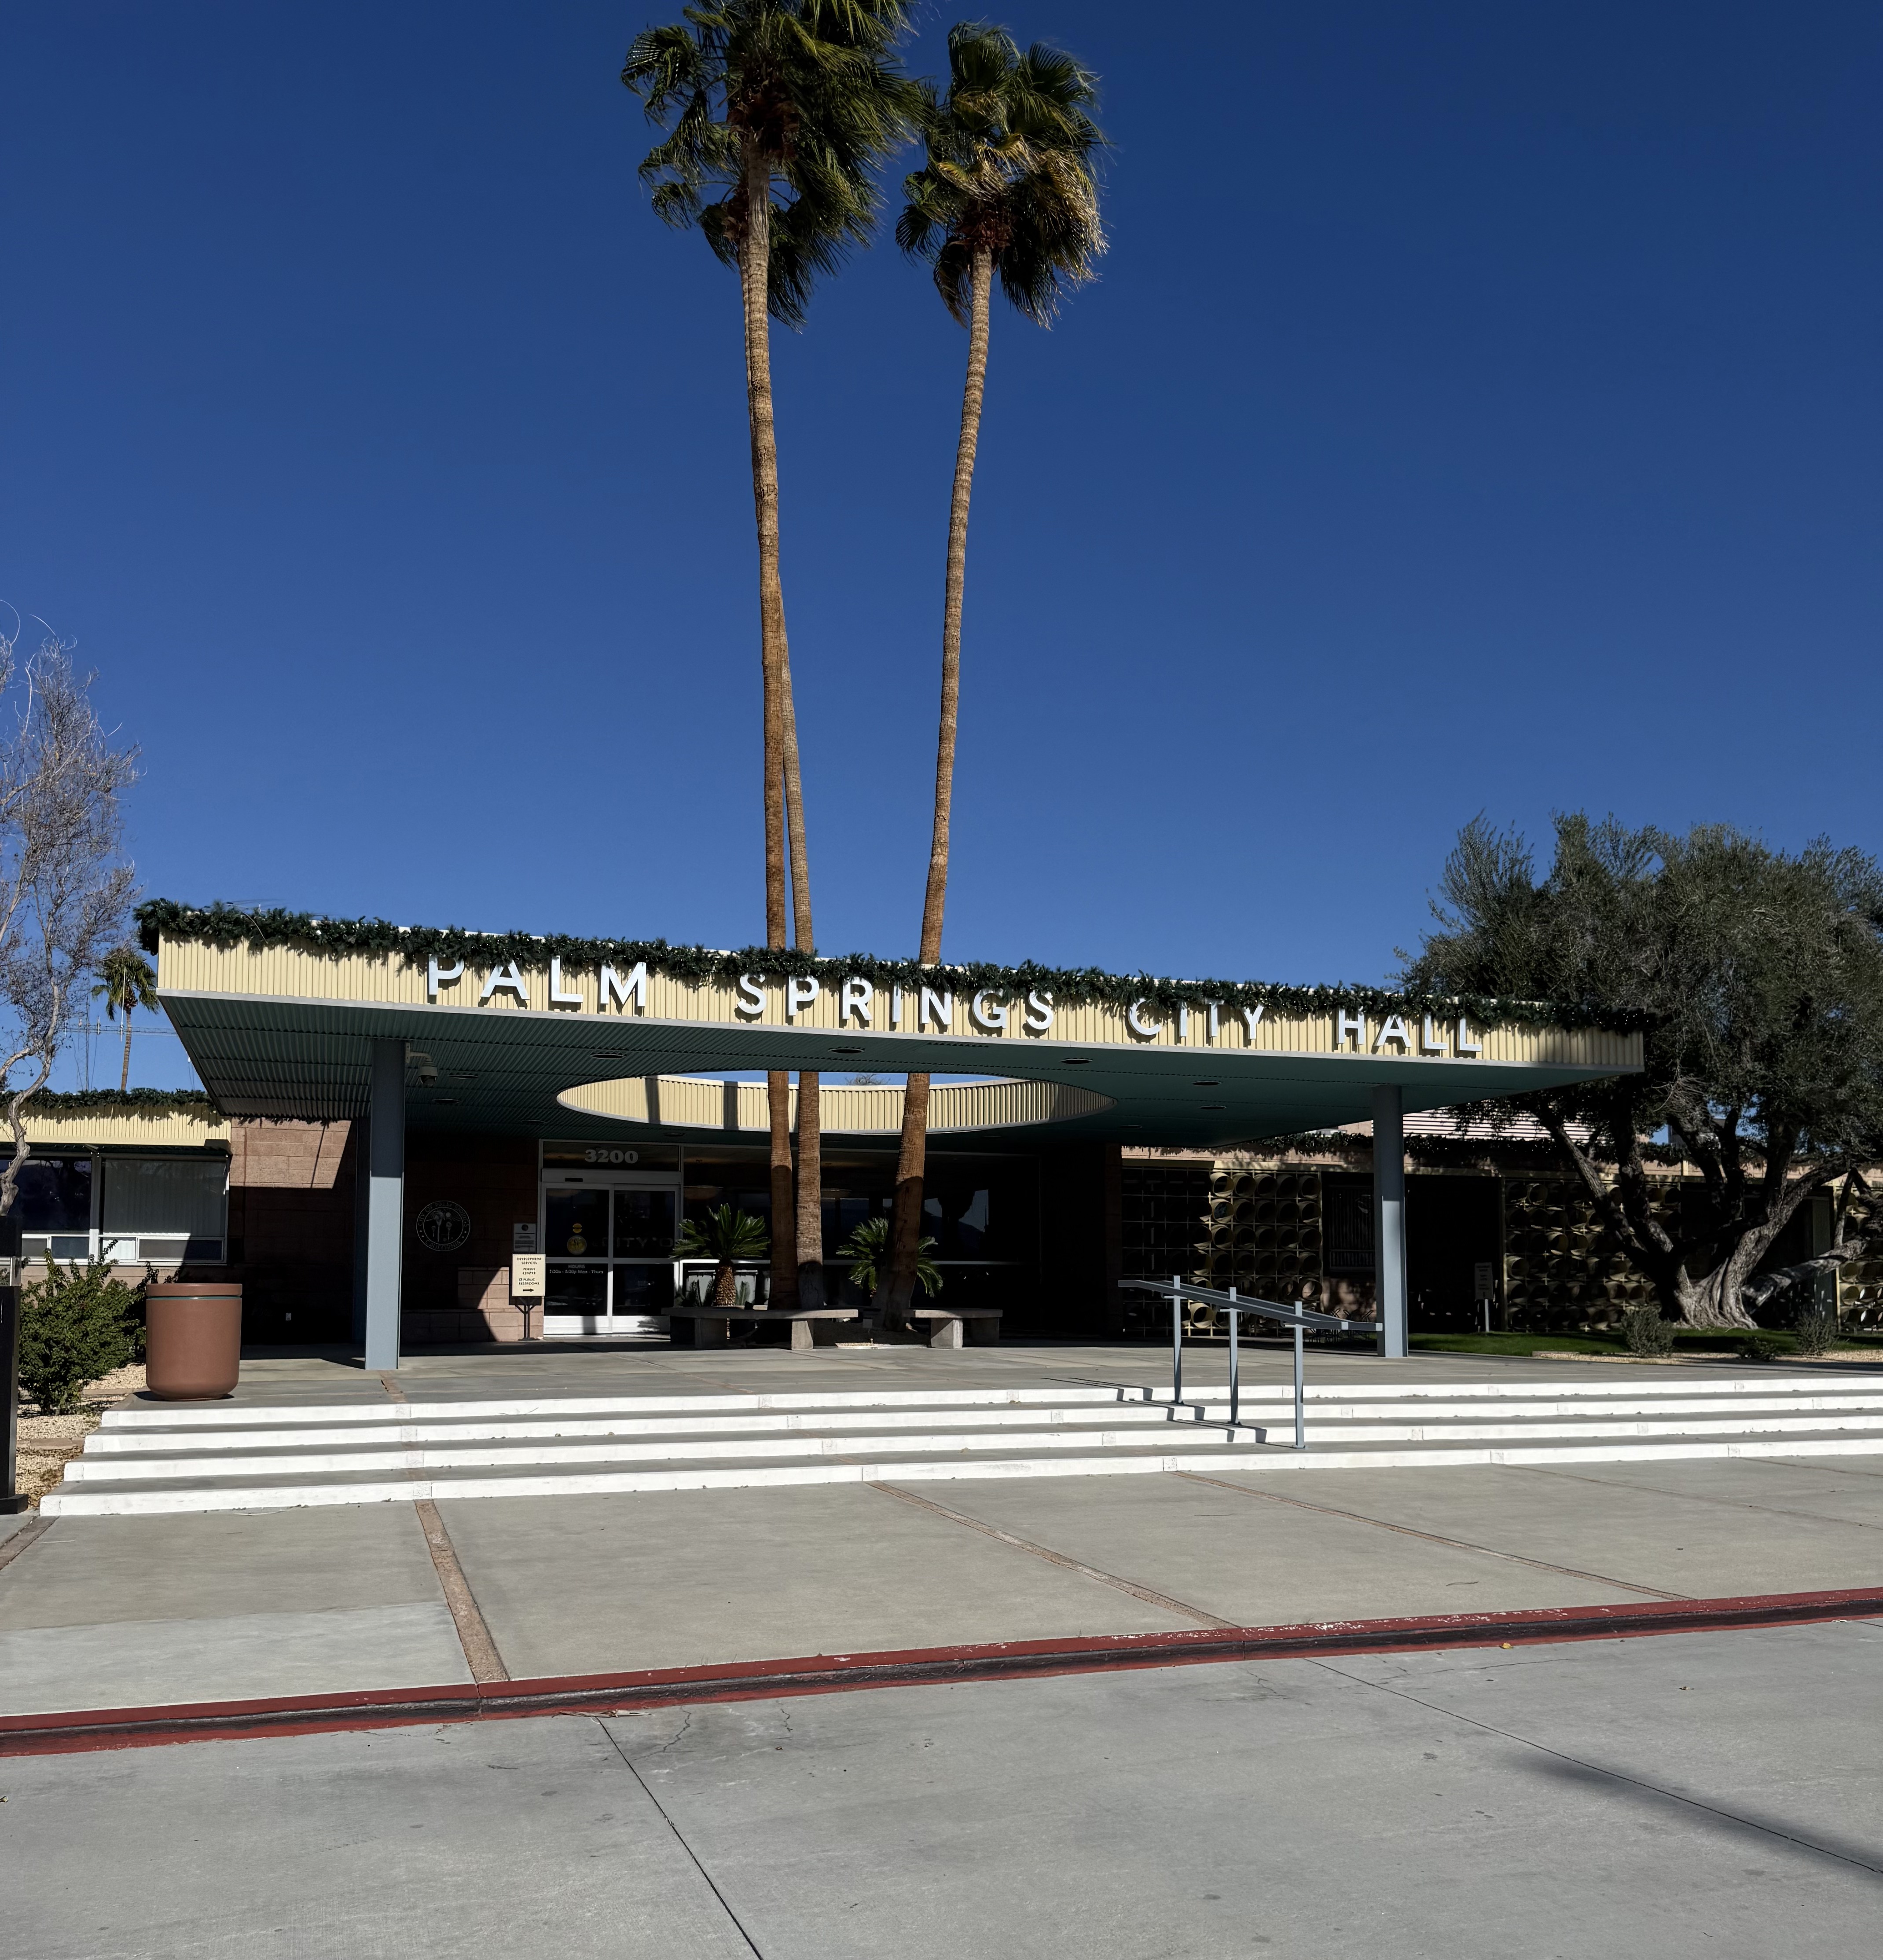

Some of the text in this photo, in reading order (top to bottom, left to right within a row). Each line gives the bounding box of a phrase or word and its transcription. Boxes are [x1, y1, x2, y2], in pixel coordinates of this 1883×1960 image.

[429, 954, 1483, 1051] PALM SPRINGS CITY HALL
[584, 1149, 639, 1164] 3200
